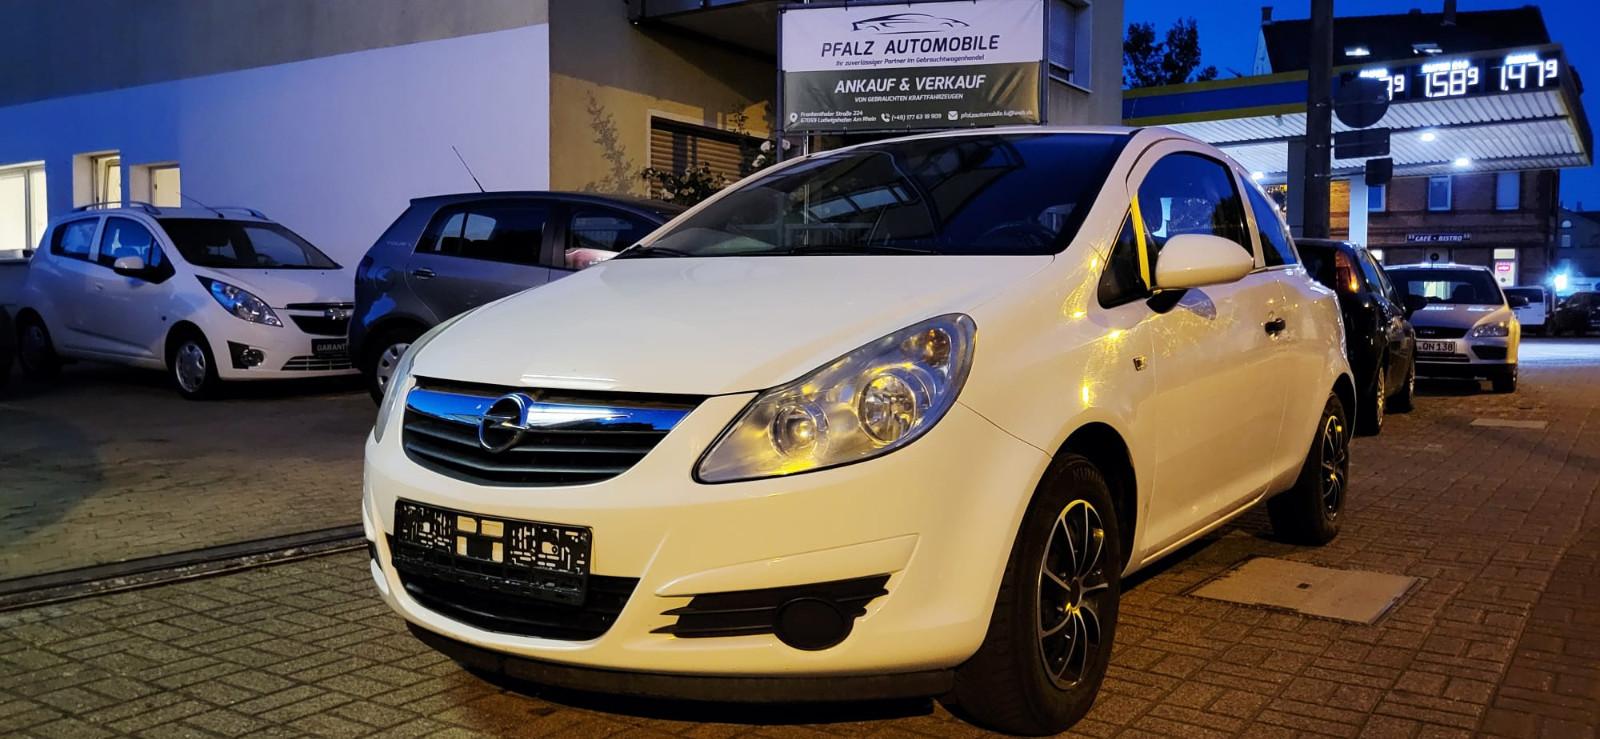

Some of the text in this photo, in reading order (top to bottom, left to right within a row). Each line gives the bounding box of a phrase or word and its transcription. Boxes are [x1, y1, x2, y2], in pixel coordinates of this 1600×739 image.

[821, 35, 1000, 57] PFALZ AUTOMOBILE
[916, 55, 984, 63] Gebrauchtwagenhandel
[834, 75, 986, 93] ANKAUF & VERKAUF
[908, 93, 964, 101] KRAFTFAHRZEUGEN
